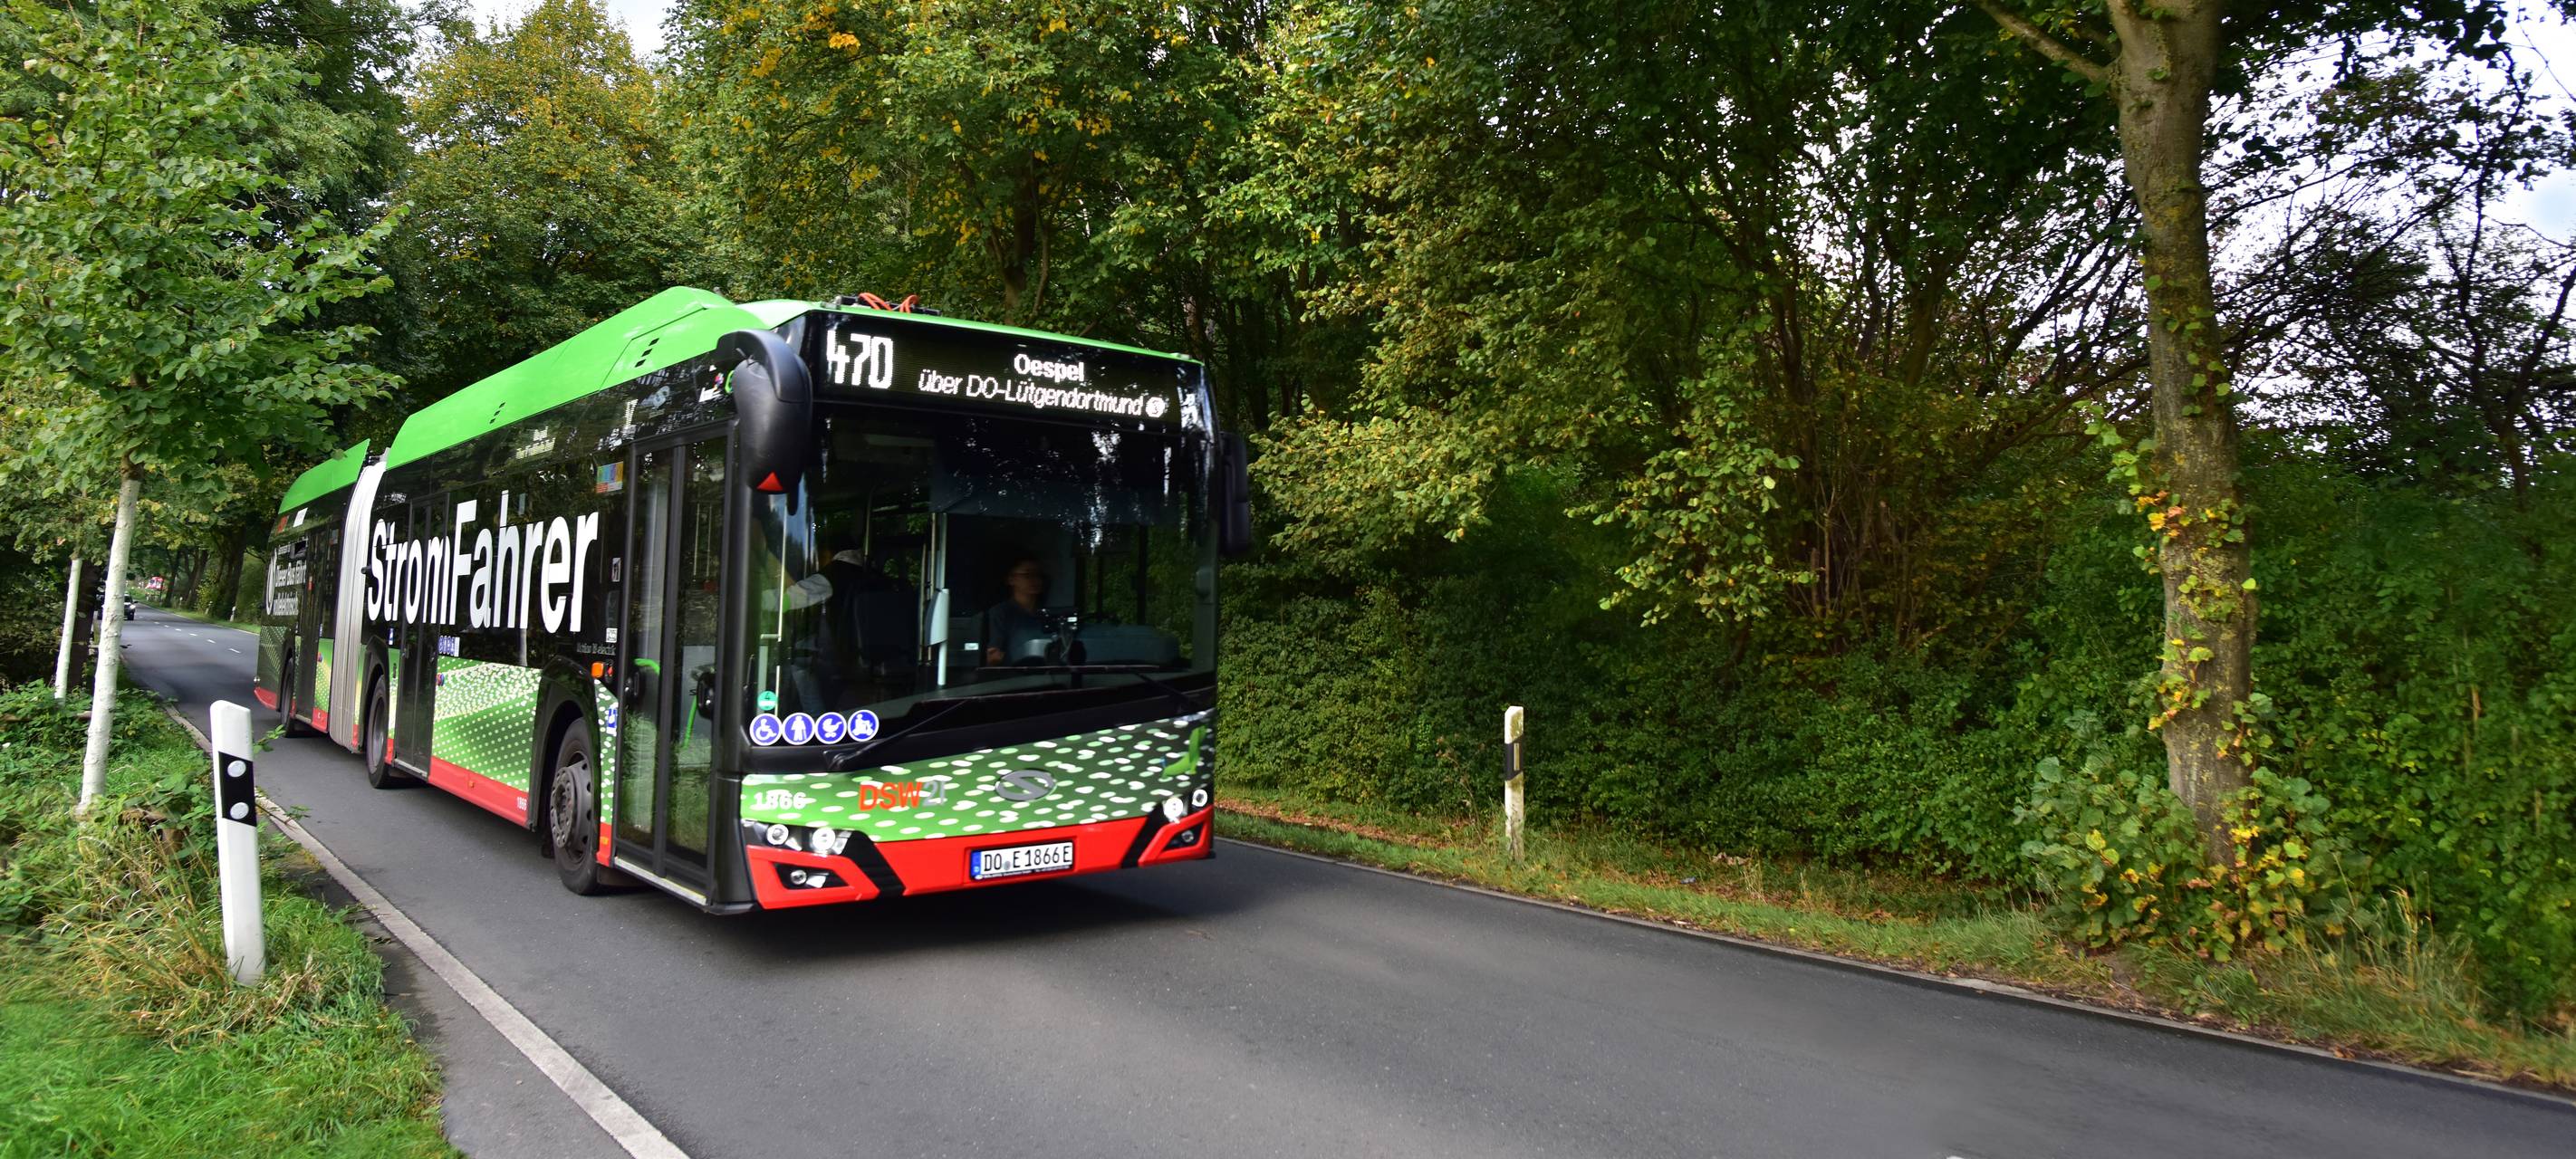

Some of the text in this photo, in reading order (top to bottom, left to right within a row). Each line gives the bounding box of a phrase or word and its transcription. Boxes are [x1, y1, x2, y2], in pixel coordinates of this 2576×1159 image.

[826, 330, 894, 389] 470
[1014, 353, 1085, 383] Oespel
[918, 369, 963, 395] über
[966, 374, 1144, 417] DO-Lütgendortmund
[367, 490, 599, 633] StromFahrer
[754, 790, 806, 810] 1866
[984, 853, 1002, 872] DO
